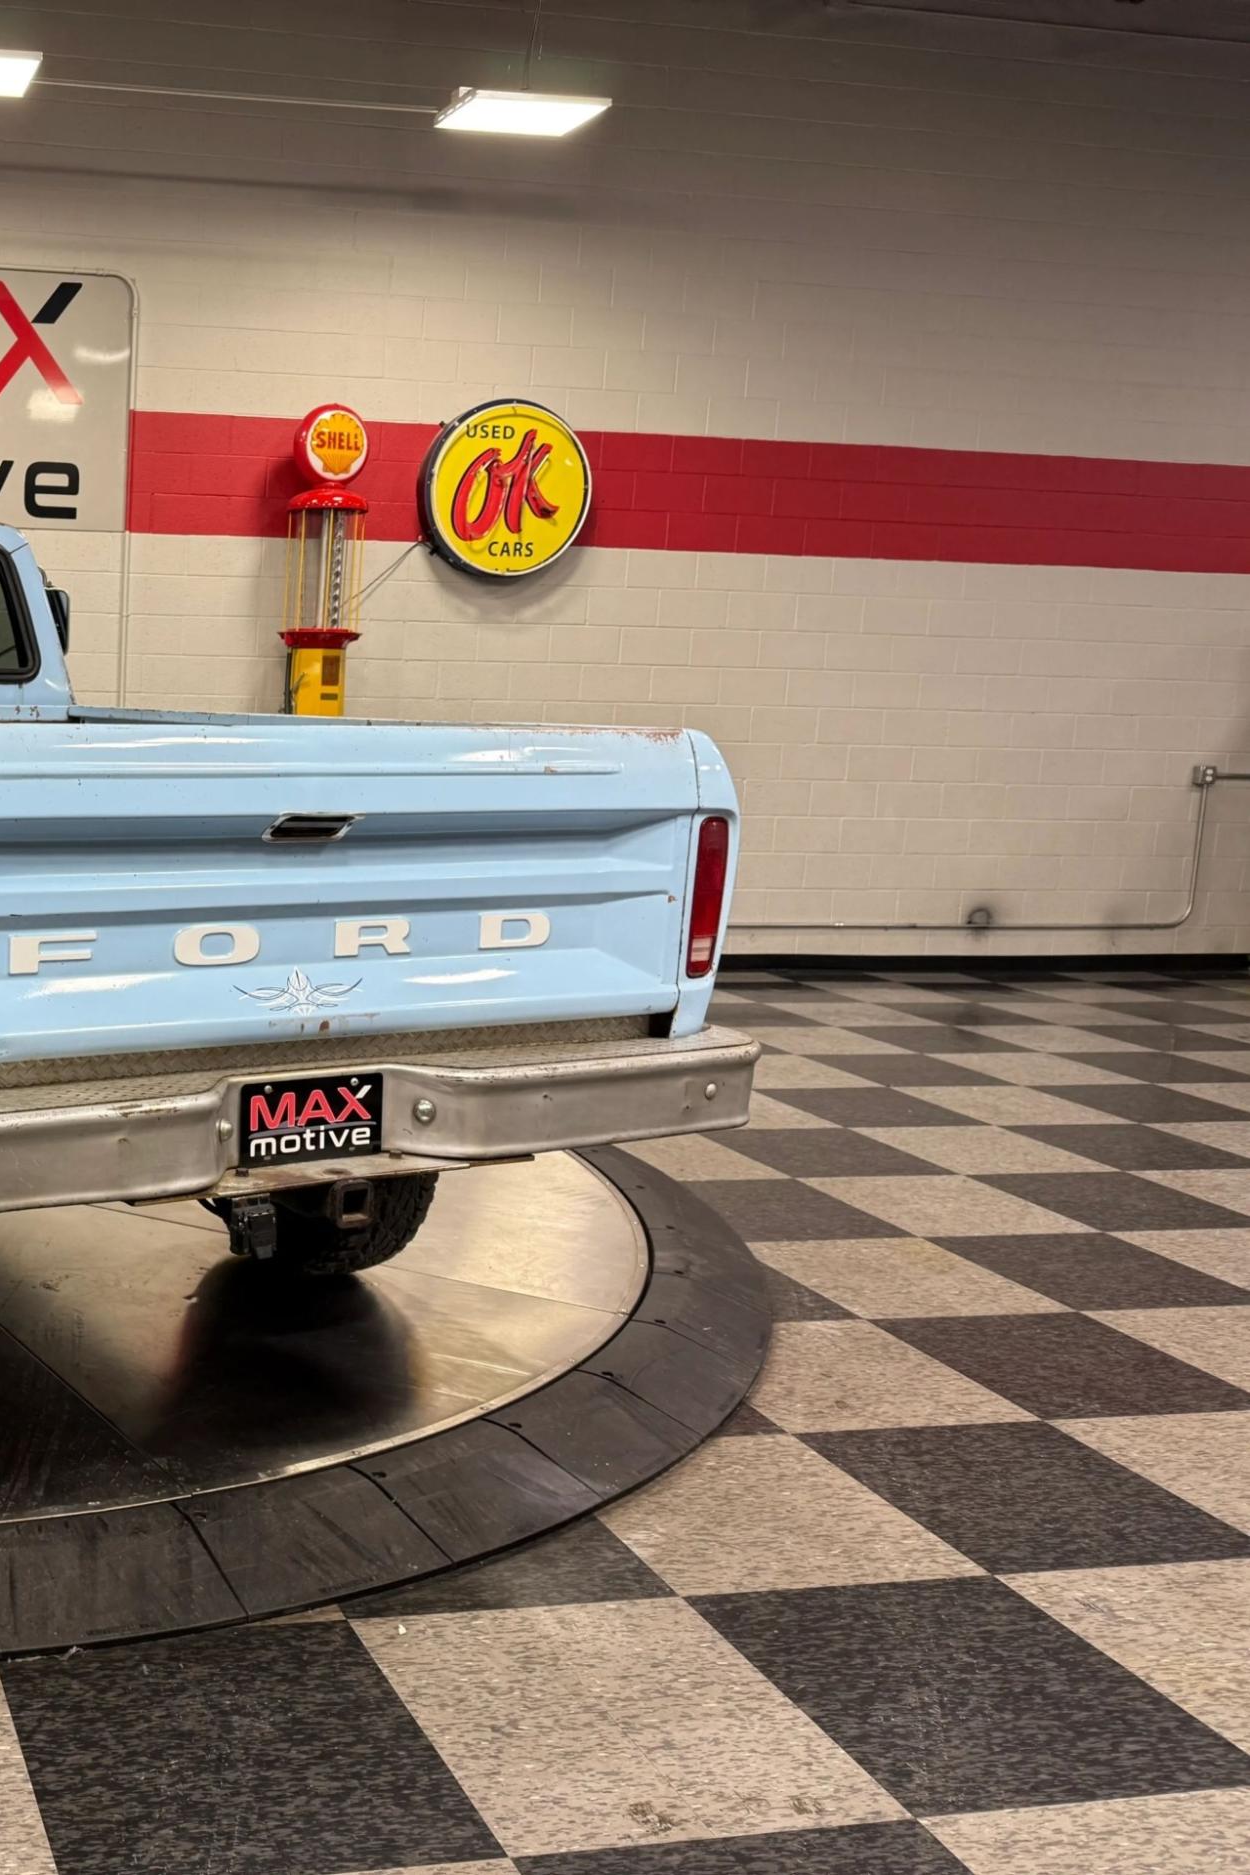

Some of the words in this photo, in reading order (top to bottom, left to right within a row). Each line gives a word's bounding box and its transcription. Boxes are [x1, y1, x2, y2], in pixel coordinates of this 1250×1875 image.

[315, 431, 361, 451] SHELL
[466, 424, 515, 439] USED
[451, 429, 560, 541] OK
[488, 541, 534, 557] CARS
[8, 911, 551, 975] FORD
[250, 1085, 372, 1131] MAX
[250, 1126, 371, 1158] motive
